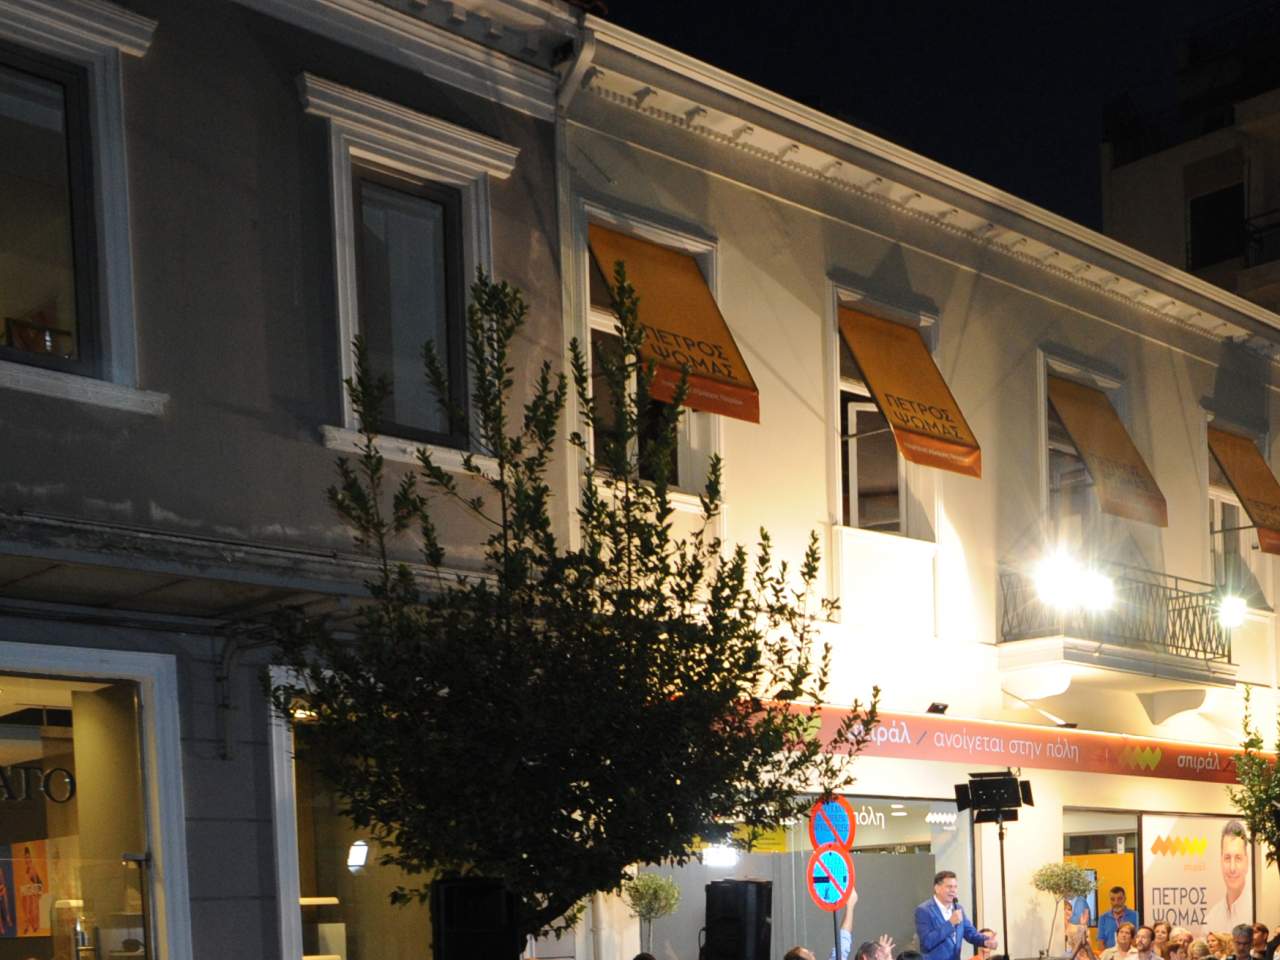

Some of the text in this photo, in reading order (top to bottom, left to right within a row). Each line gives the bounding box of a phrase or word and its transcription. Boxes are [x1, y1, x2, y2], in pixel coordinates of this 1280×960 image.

[640, 322, 729, 362] ΠΕΤΡΟΣ
[650, 343, 738, 380] ΨΩΜΑΣ
[884, 393, 954, 422] ΠΕΤΡΟΣ
[894, 410, 964, 440] ΨΩΜΑΣ
[934, 728, 1005, 754] ανοίγεται
[1008, 739, 1042, 760] στην
[1046, 738, 1080, 762] πόλη
[1177, 752, 1221, 773] σπιράλ
[1152, 886, 1208, 905] ΠΕΤΡΟΣ
[1152, 907, 1208, 926] ΨΩΜΑΣ
